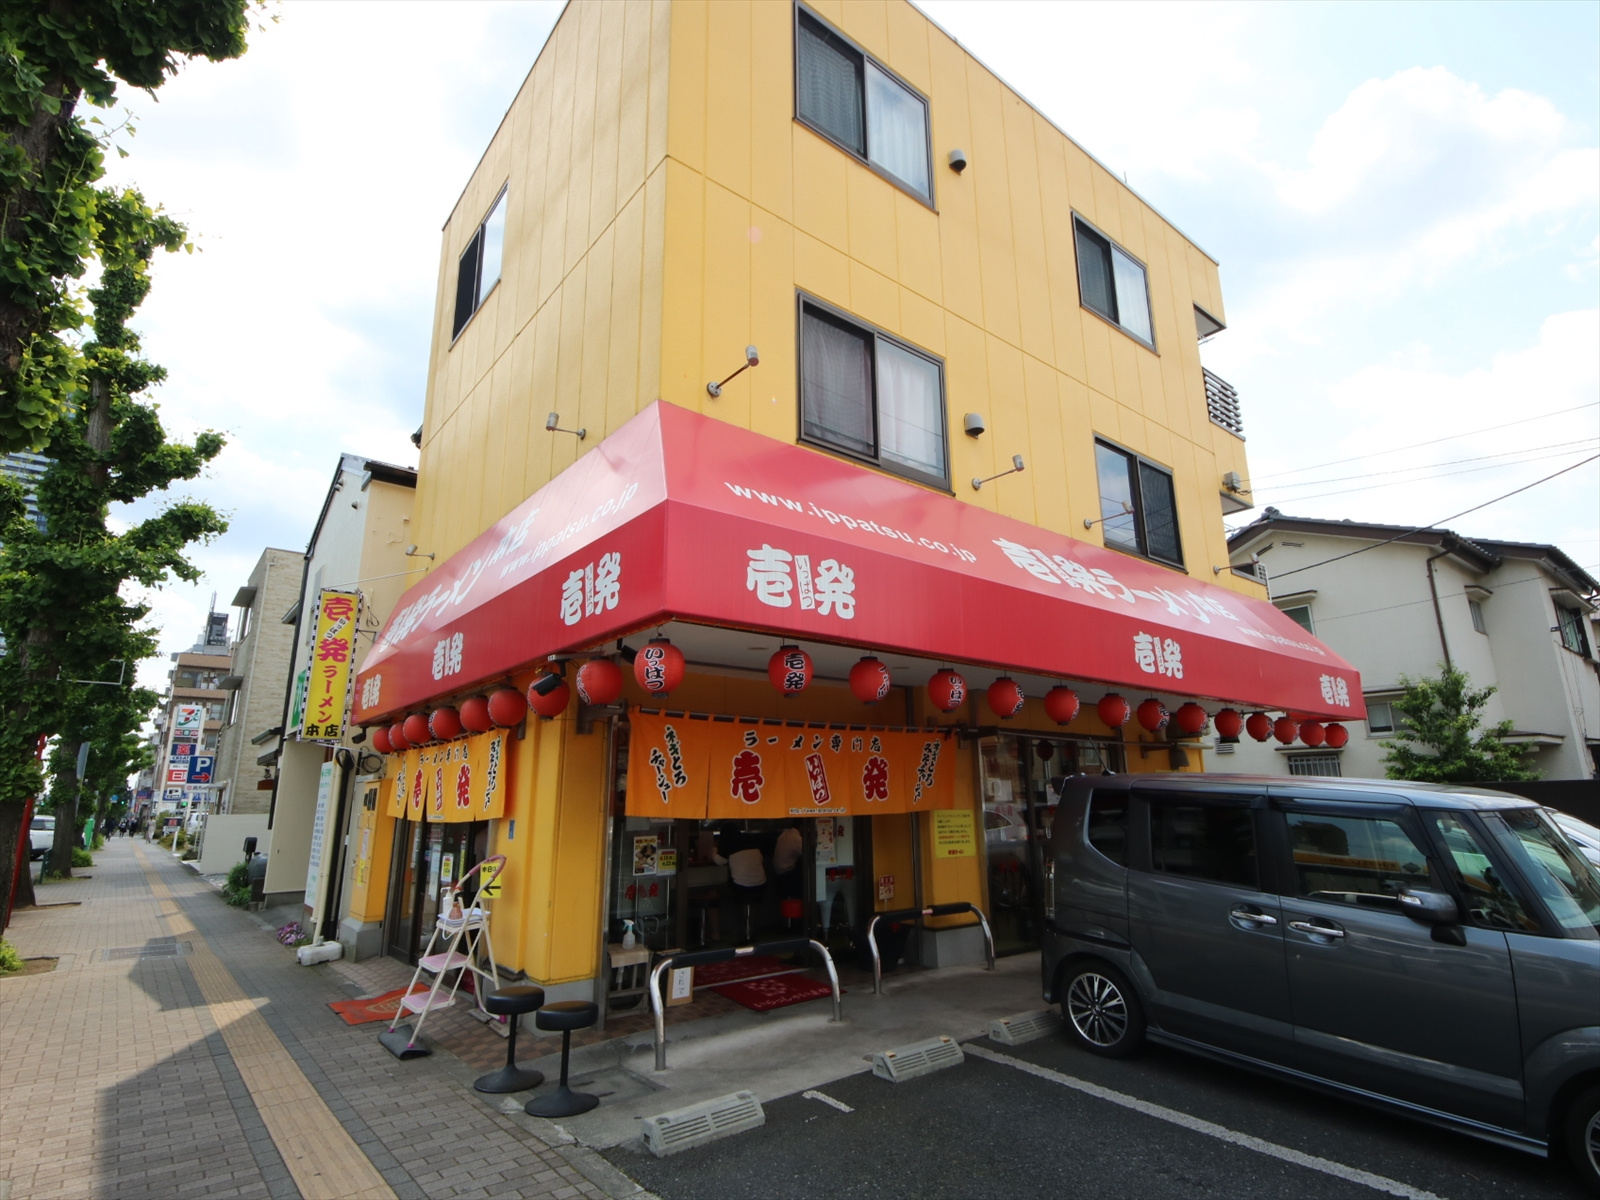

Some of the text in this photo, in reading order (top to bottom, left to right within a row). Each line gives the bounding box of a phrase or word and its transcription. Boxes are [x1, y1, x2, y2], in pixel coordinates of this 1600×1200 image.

[499, 482, 639, 579] www.ippatsu.co.jp
[724, 481, 978, 564] www.ippatsu.co.jp
[784, 653, 805, 690] 壱発
[305, 723, 340, 737] 本店
[743, 730, 883, 753] ラーメン専門店
[195, 757, 211, 773] P
